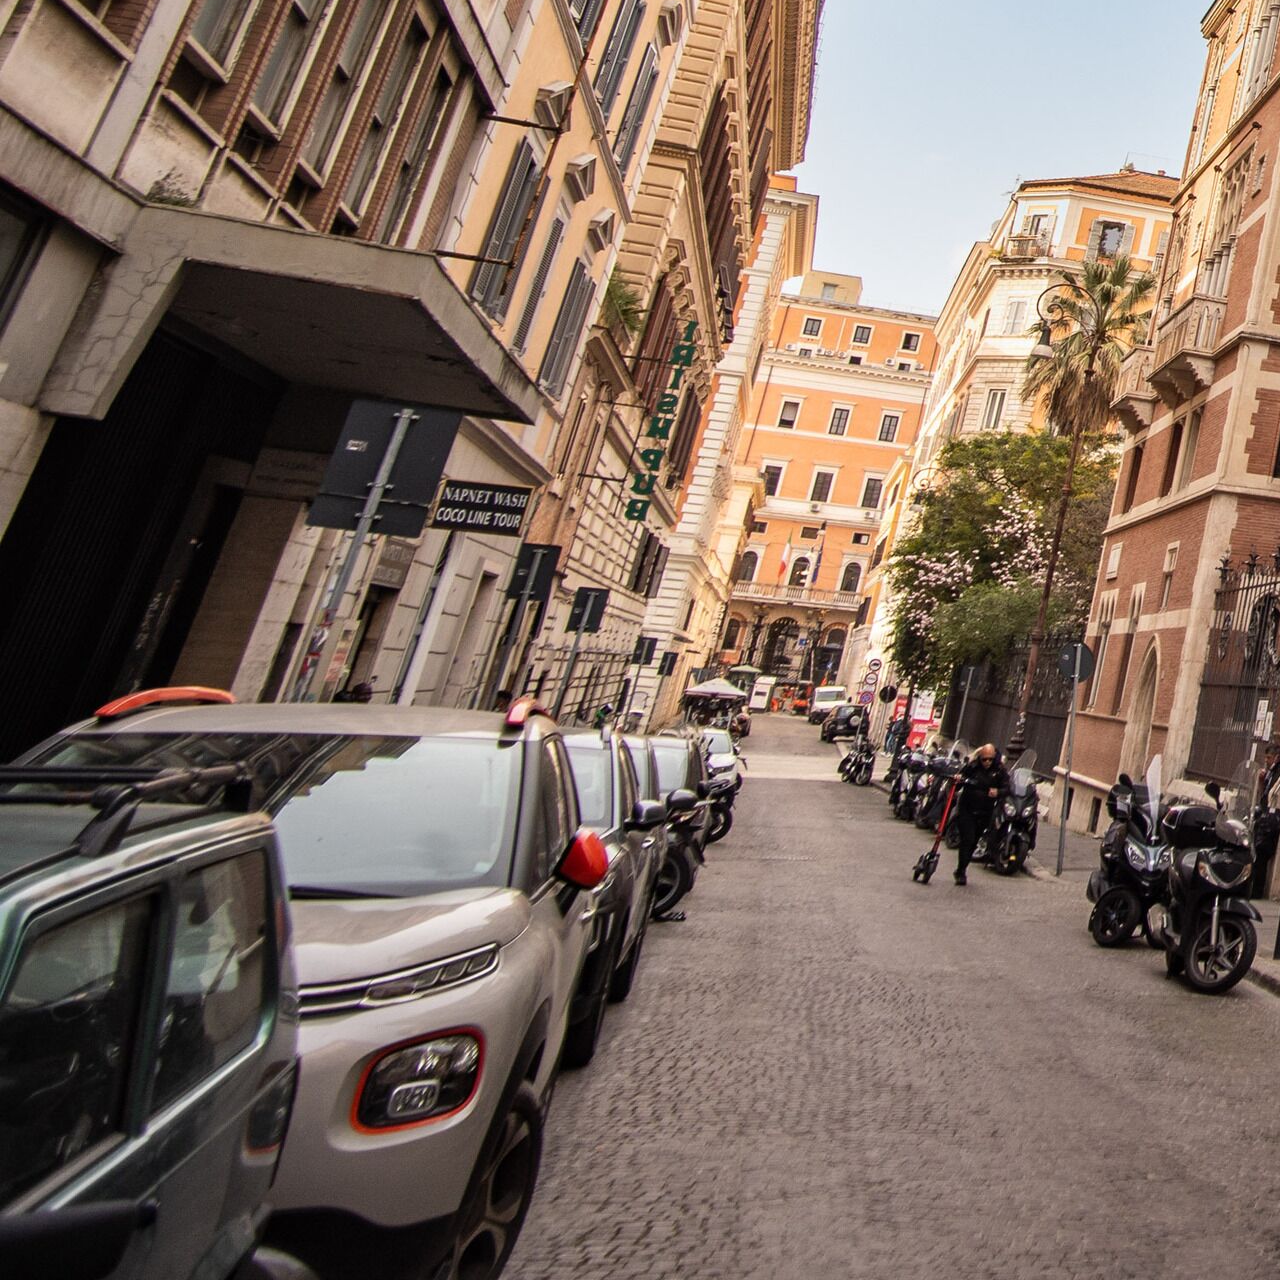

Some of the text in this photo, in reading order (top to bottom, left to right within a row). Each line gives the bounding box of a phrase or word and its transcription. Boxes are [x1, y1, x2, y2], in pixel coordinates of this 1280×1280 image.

[442, 487, 529, 508] NAPNET WASH
[436, 507, 521, 528] COCO LINE TOUR
